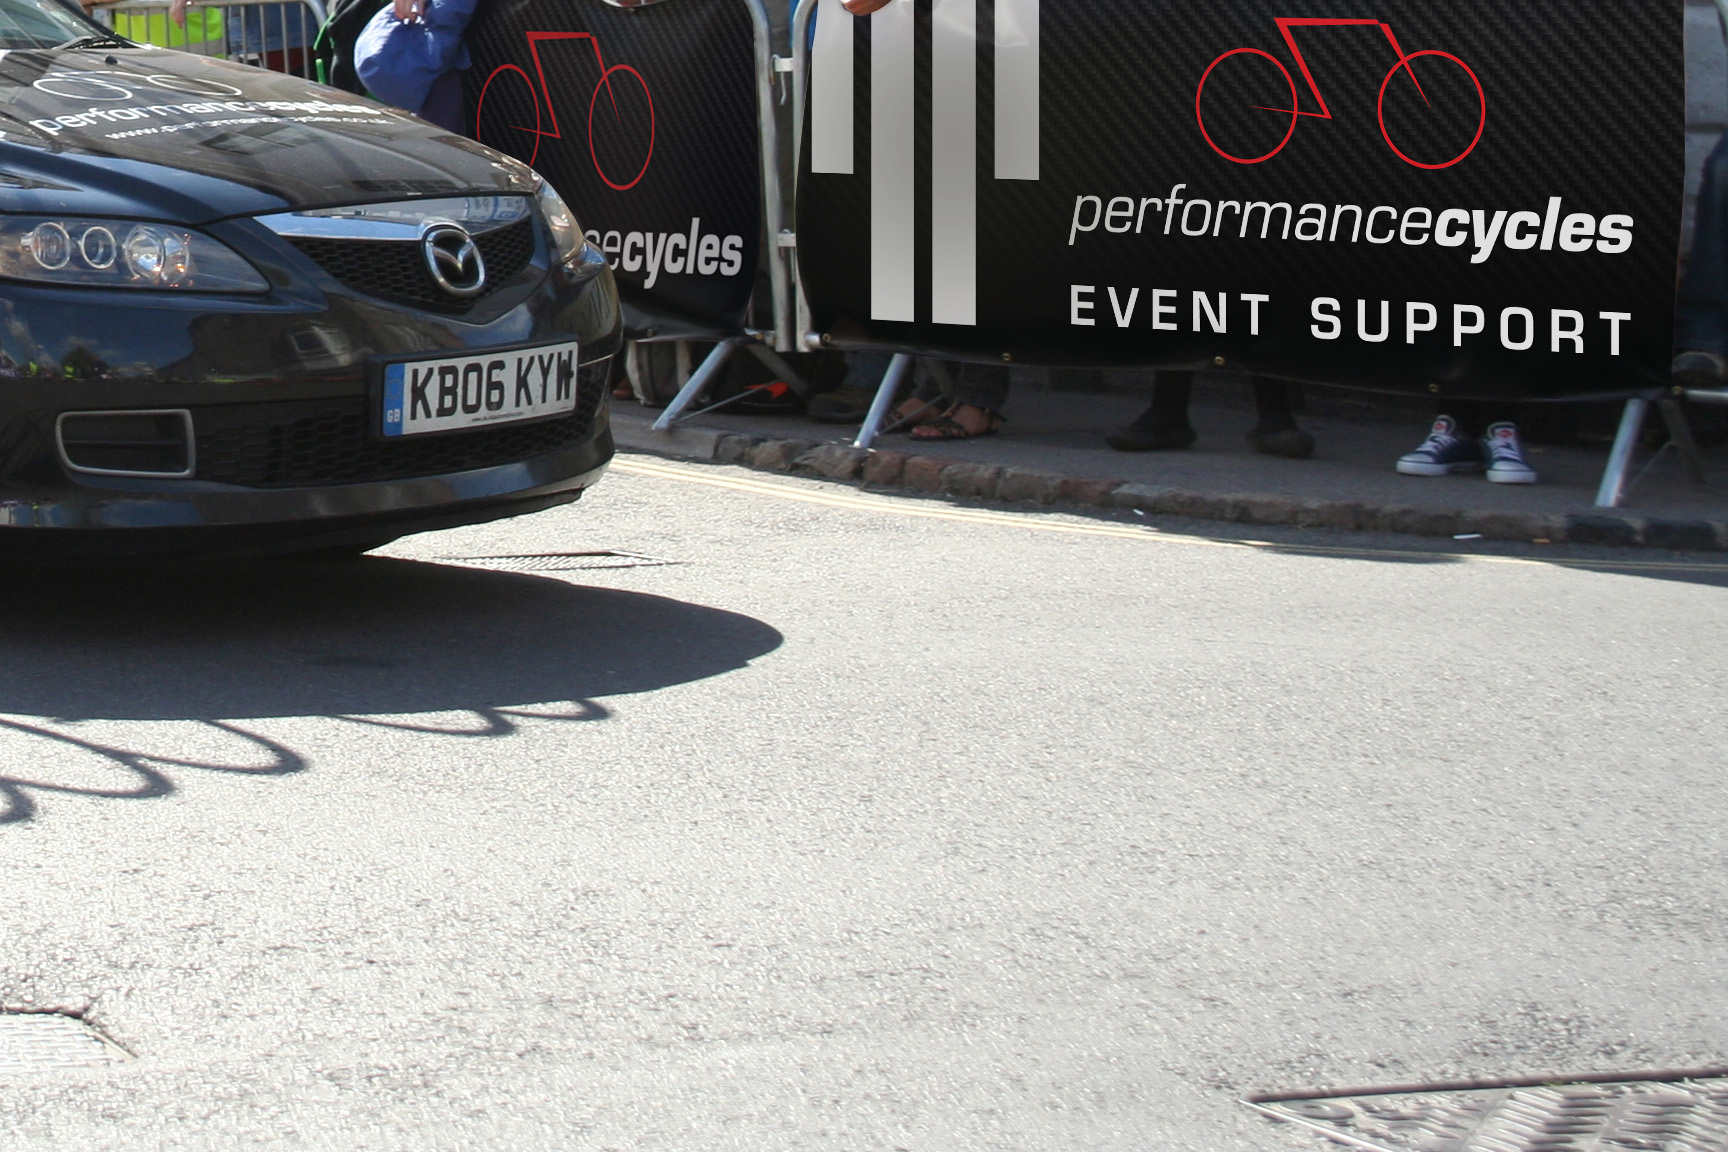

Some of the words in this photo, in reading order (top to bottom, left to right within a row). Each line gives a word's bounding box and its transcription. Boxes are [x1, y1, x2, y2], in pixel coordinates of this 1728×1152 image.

[1068, 183, 1634, 264] performancecycles
[1071, 284, 1270, 336] EVENT
[1310, 297, 1632, 356] SUPPORT
[387, 408, 401, 423] GB
[410, 359, 507, 421] KB06
[514, 350, 574, 408] KYW
